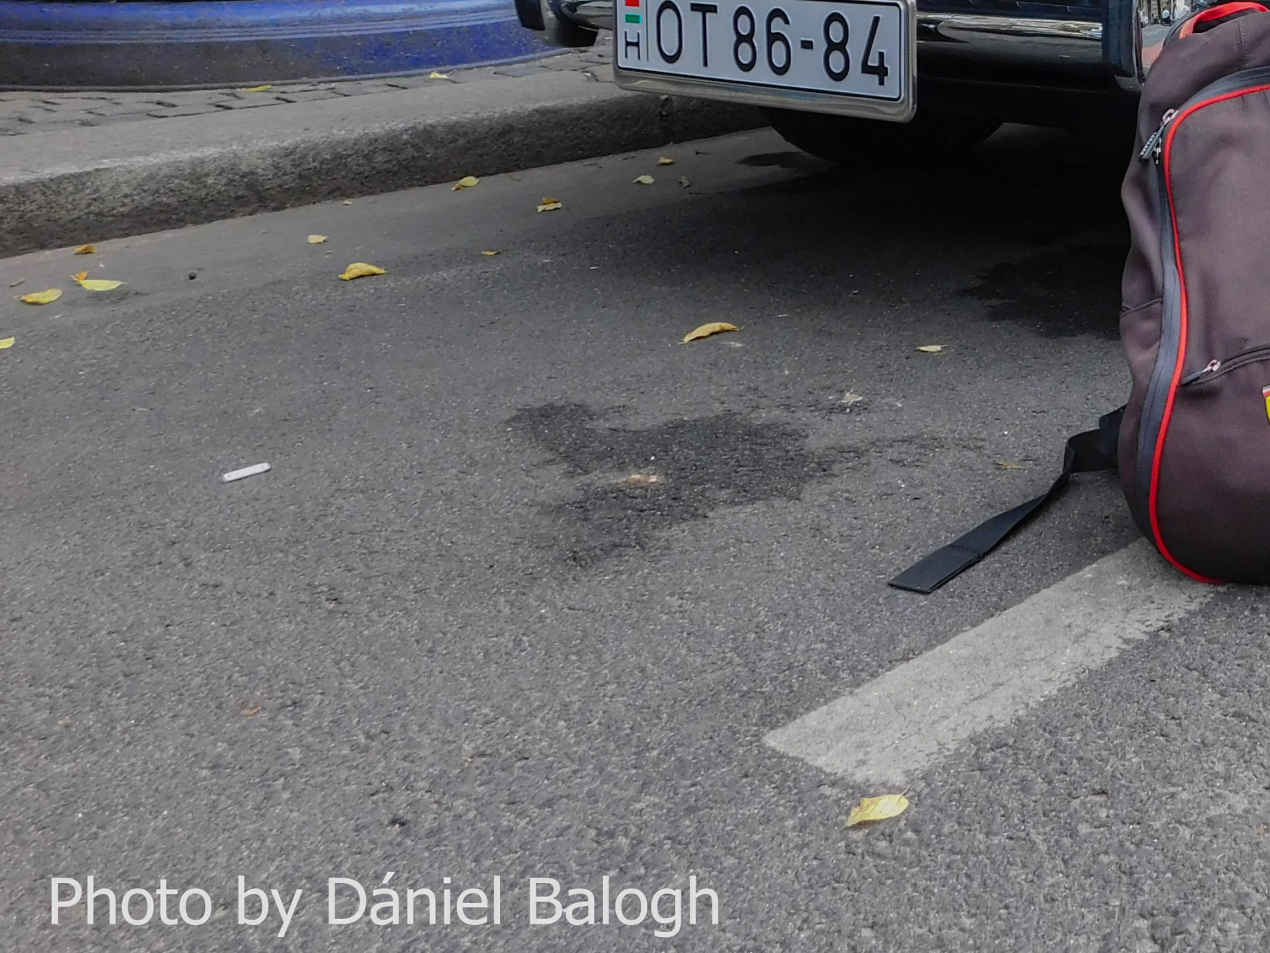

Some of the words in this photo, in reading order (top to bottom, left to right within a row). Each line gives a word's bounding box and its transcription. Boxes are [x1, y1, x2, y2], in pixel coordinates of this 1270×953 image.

[624, 30, 641, 61] H
[655, 0, 718, 67] OT
[732, 5, 889, 86] 86-84
